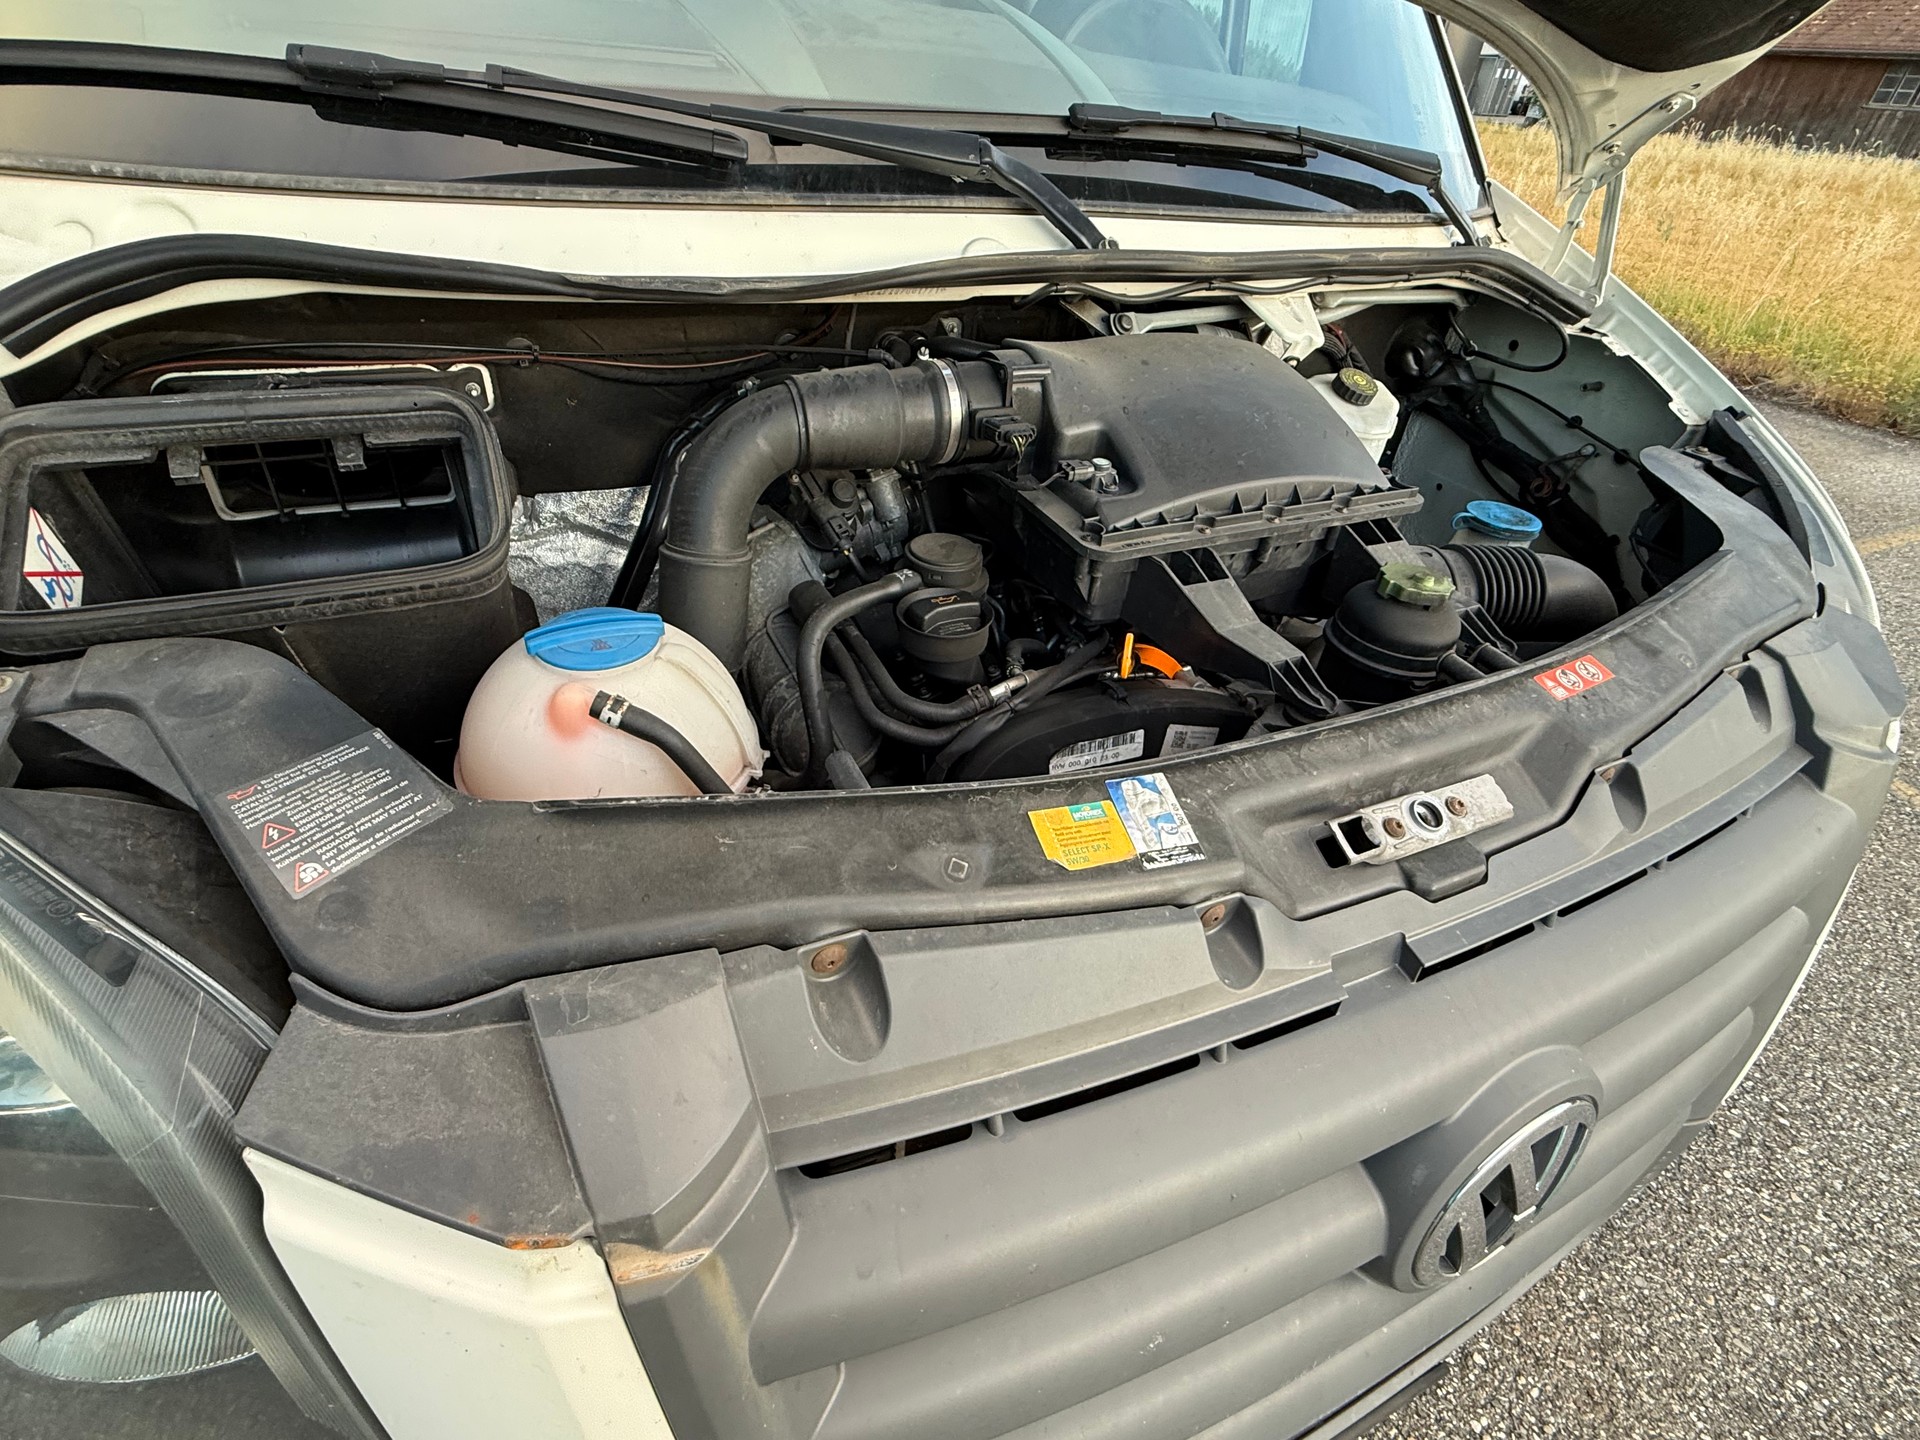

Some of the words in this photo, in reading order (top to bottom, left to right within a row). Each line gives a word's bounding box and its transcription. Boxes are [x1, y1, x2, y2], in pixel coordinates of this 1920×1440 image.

[230, 786, 278, 809] OVERFILLED
[278, 774, 307, 788] ENGINE
[321, 760, 338, 769] CAN
[338, 746, 370, 762] DAMAGE
[351, 770, 364, 778] der
[290, 809, 311, 822] HIGH
[346, 776, 377, 793] SWITCH
[376, 769, 391, 778] OFF
[294, 810, 324, 827] ENGINE
[323, 795, 353, 812] BEFORE
[353, 775, 392, 796] TOUCHING
[328, 783, 351, 795] Motor
[237, 795, 287, 819] Remplissage
[241, 803, 282, 824] dangereux
[284, 794, 302, 804] pour
[266, 842, 291, 857] Haute
[353, 795, 380, 810] moteur
[379, 785, 399, 797] avant
[298, 812, 334, 832] IGNITION
[335, 795, 367, 813] SYSTEM
[315, 831, 356, 855] RADIATOR
[355, 822, 372, 833] FAN
[371, 813, 390, 824] MAY
[389, 800, 413, 815] START
[412, 794, 424, 802] AT
[325, 858, 336, 867] Le
[335, 837, 374, 861] ventilateur
[384, 813, 416, 833] radiateur
[415, 805, 432, 816] peut
[334, 824, 354, 836] kann
[353, 808, 385, 826] jederzeit
[270, 844, 301, 862] toucher
[320, 848, 339, 861] ANY
[376, 835, 392, 846] tout
[1062, 846, 1090, 857] SELECT
[1066, 855, 1090, 865] 5W/30
